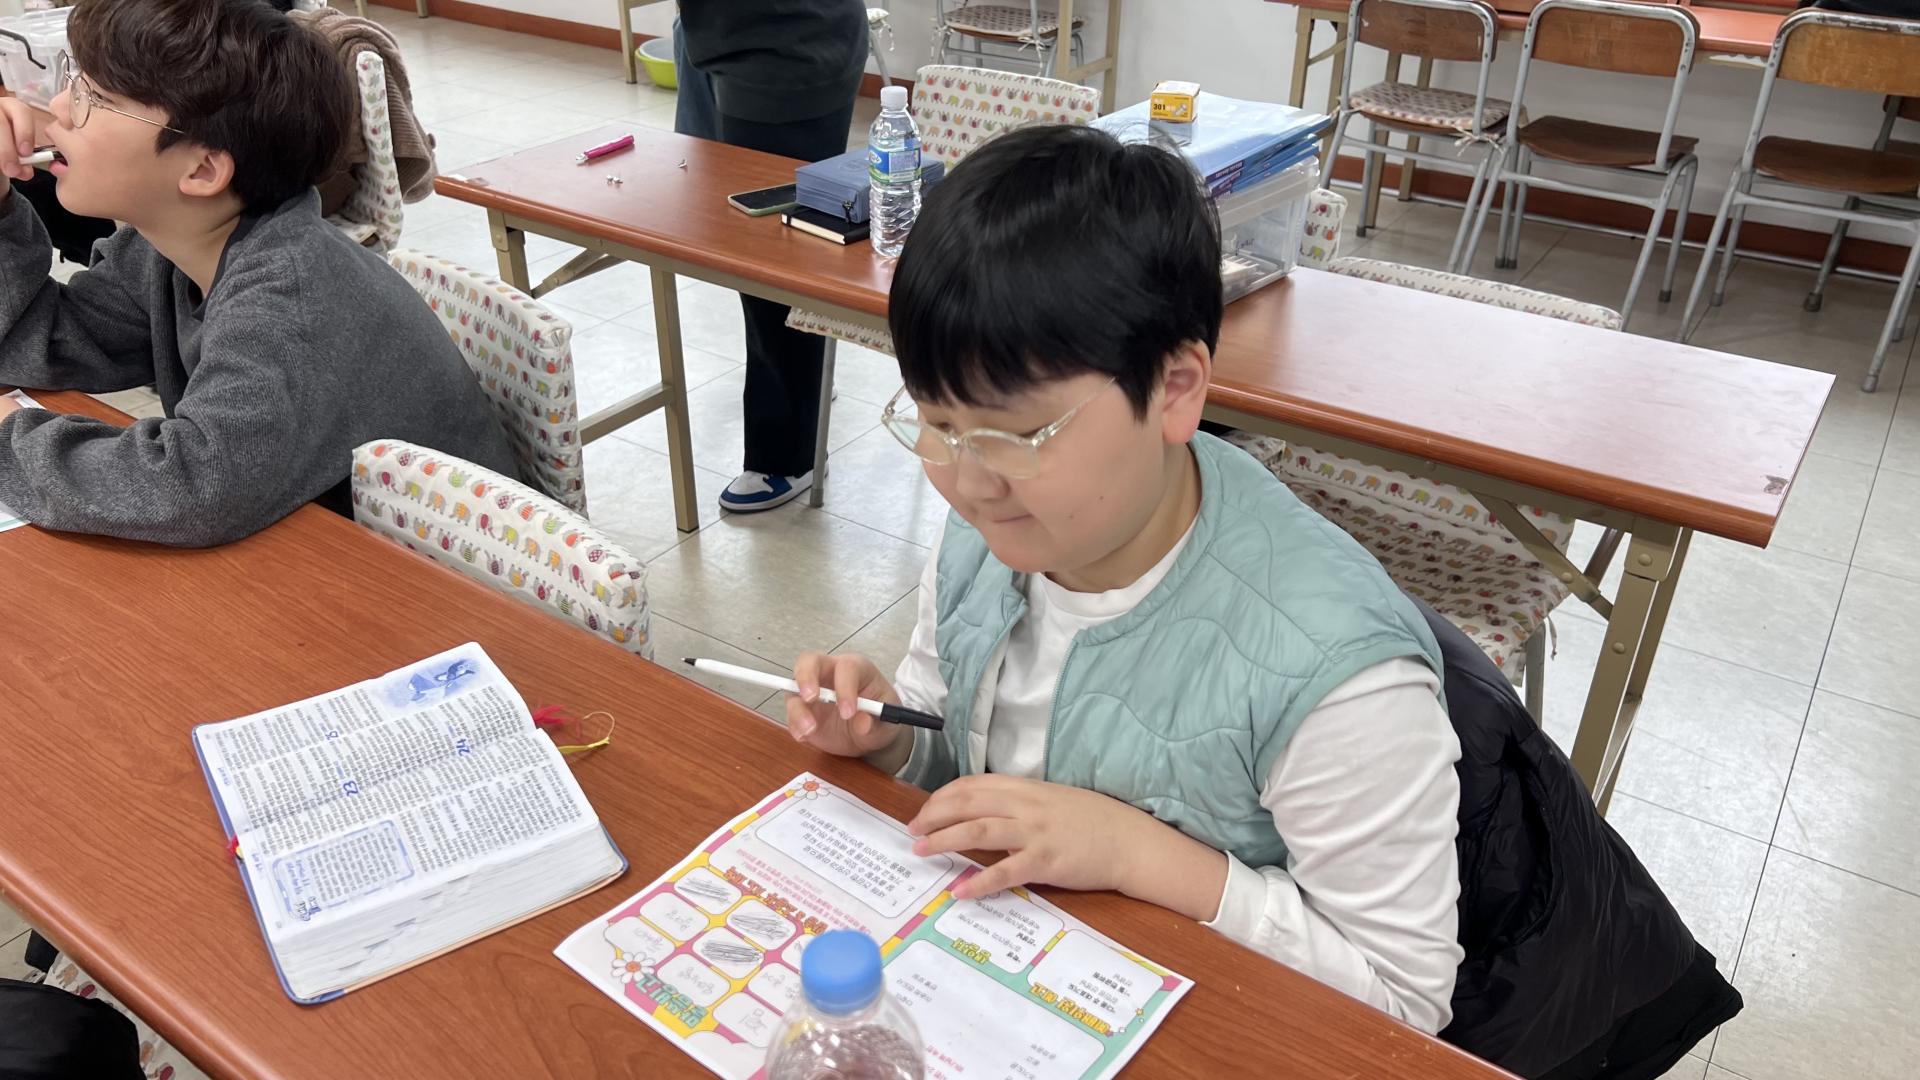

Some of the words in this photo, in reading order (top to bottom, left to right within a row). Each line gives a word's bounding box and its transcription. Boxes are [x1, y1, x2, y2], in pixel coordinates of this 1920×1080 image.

[456, 738, 471, 757] 24
[342, 780, 359, 797] 23
[804, 845, 832, 864] 마음으로
[724, 866, 747, 885] 제목
[831, 862, 851, 876] 신앙과
[883, 870, 904, 884] 기독교
[744, 879, 766, 896] 기도
[850, 874, 872, 889] 건강한
[765, 892, 797, 916] 초등부
[803, 916, 828, 935] 말씀
[953, 937, 990, 965] 생일자
[1094, 972, 1119, 989] 헌금위원
[635, 973, 709, 1029] 말씀빙고
[1030, 982, 1059, 1004] 예고
[1069, 984, 1093, 1000] 대표기도
[1057, 997, 1112, 1034] 예배위원
